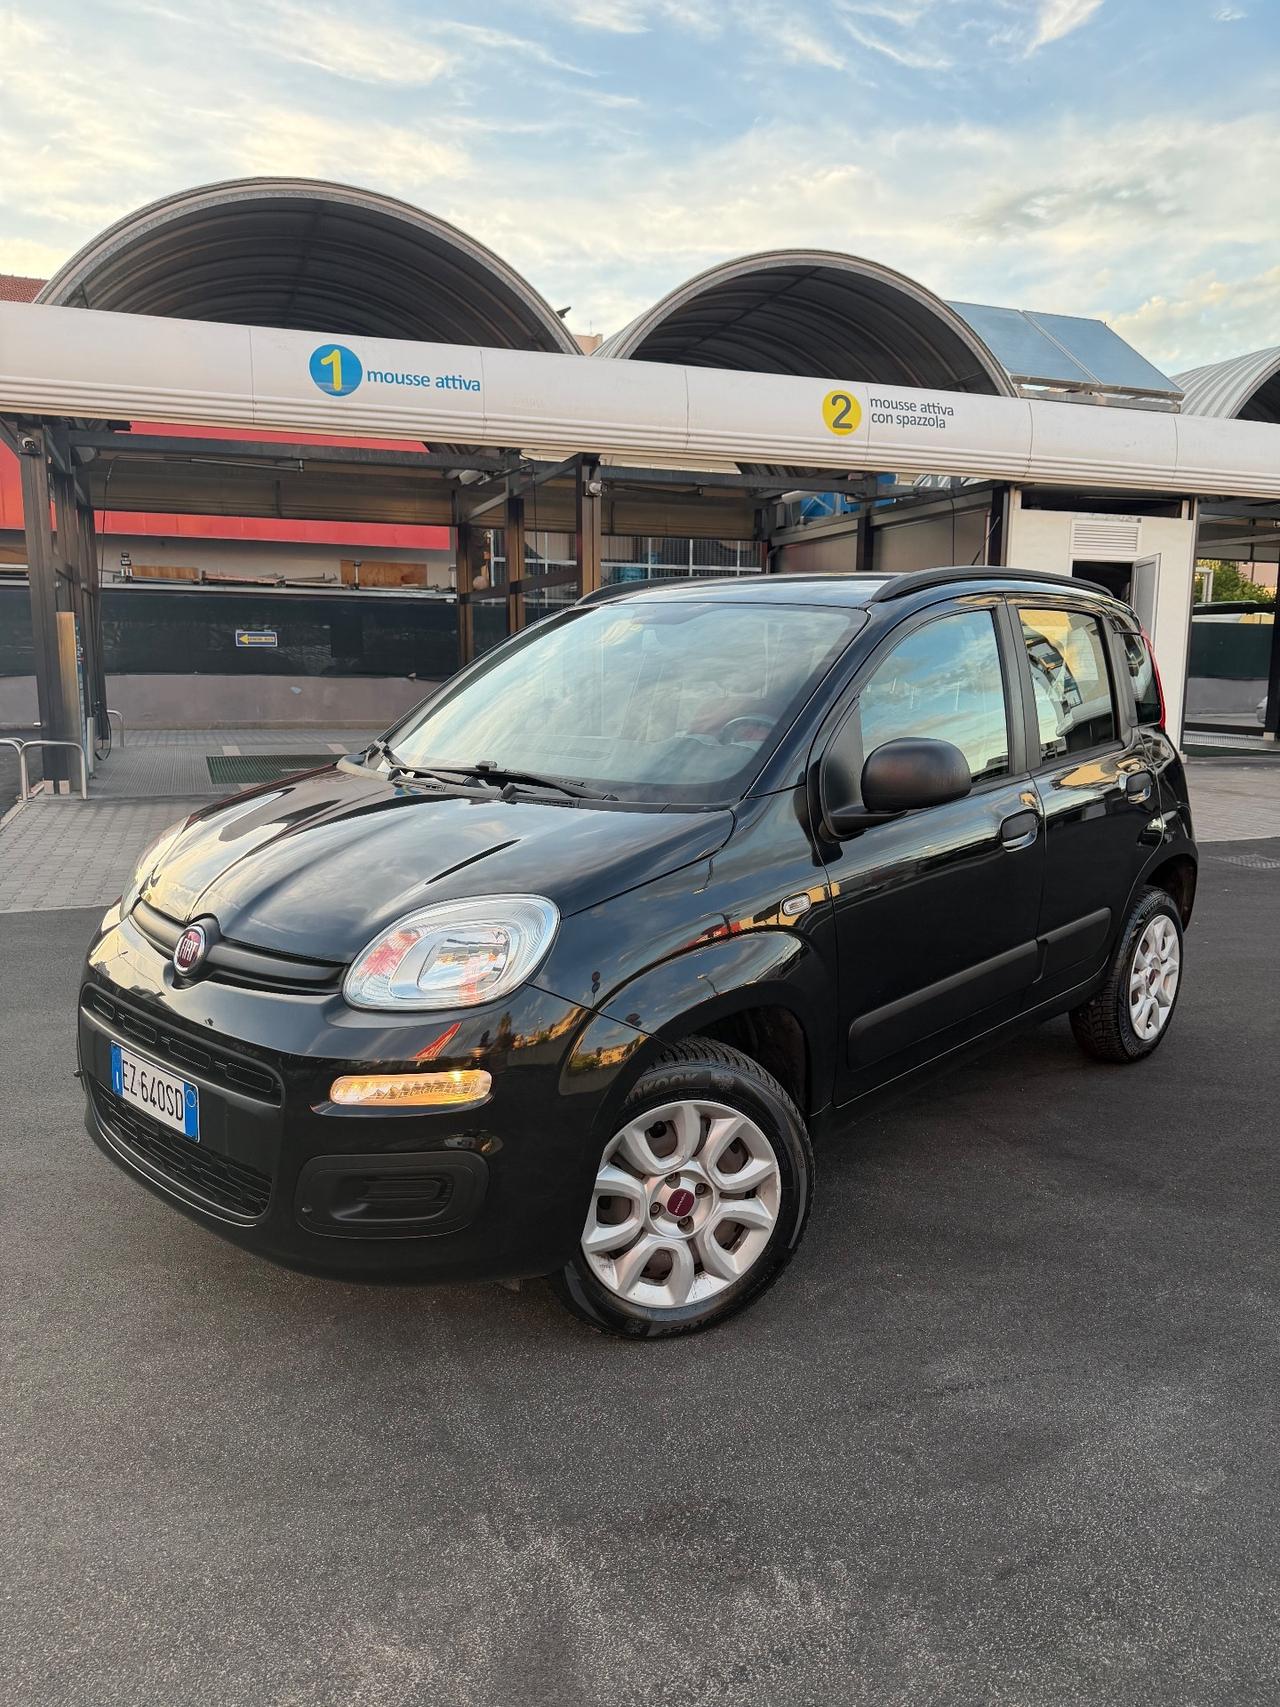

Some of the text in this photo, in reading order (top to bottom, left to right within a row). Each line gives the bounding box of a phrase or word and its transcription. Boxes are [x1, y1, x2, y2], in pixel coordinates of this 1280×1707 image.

[320, 349, 343, 392] 1
[367, 369, 481, 392] mousse attiva
[831, 394, 853, 429] 2
[870, 397, 955, 416] mousse attiva
[871, 412, 946, 429] con spazzola
[179, 937, 199, 962] FIAT
[122, 1059, 184, 1121] EZ 640SD
